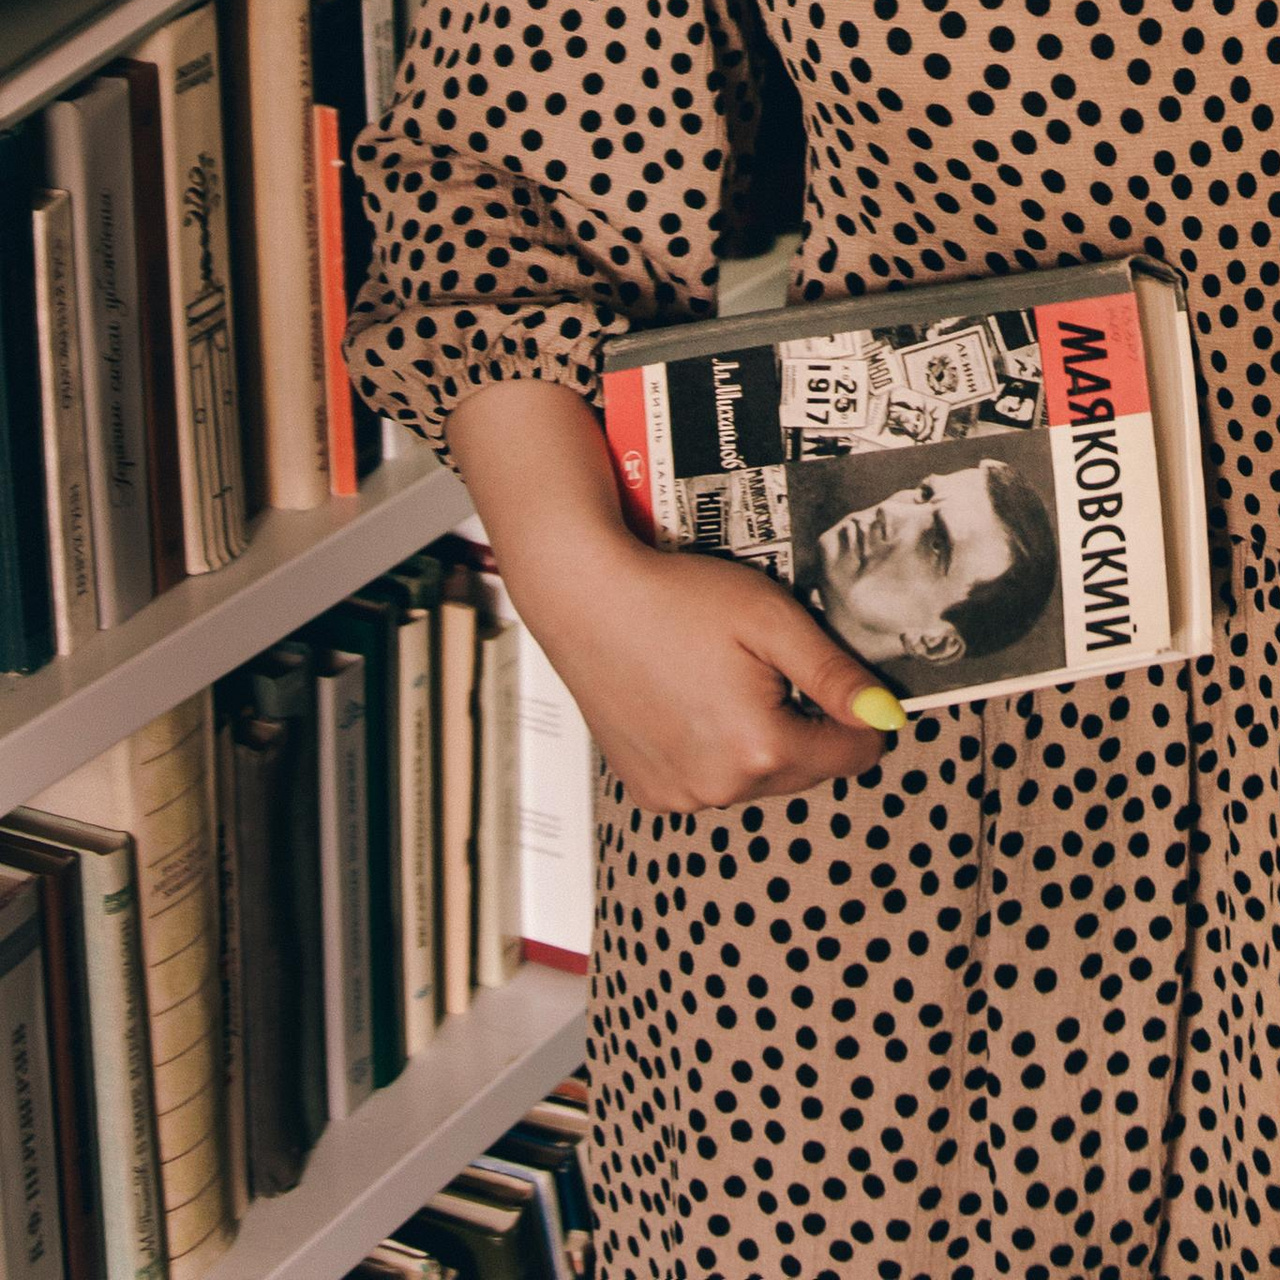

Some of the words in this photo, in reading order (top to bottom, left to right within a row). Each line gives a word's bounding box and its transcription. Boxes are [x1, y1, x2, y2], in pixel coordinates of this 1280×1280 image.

[649, 381, 664, 444] ЖИЗНЬ
[806, 365, 831, 425] 1917
[834, 379, 857, 413] 25
[655, 458, 672, 545] ЗАМЕЧАТ
[1058, 320, 1138, 652] МАЯКОВСКИЙ
